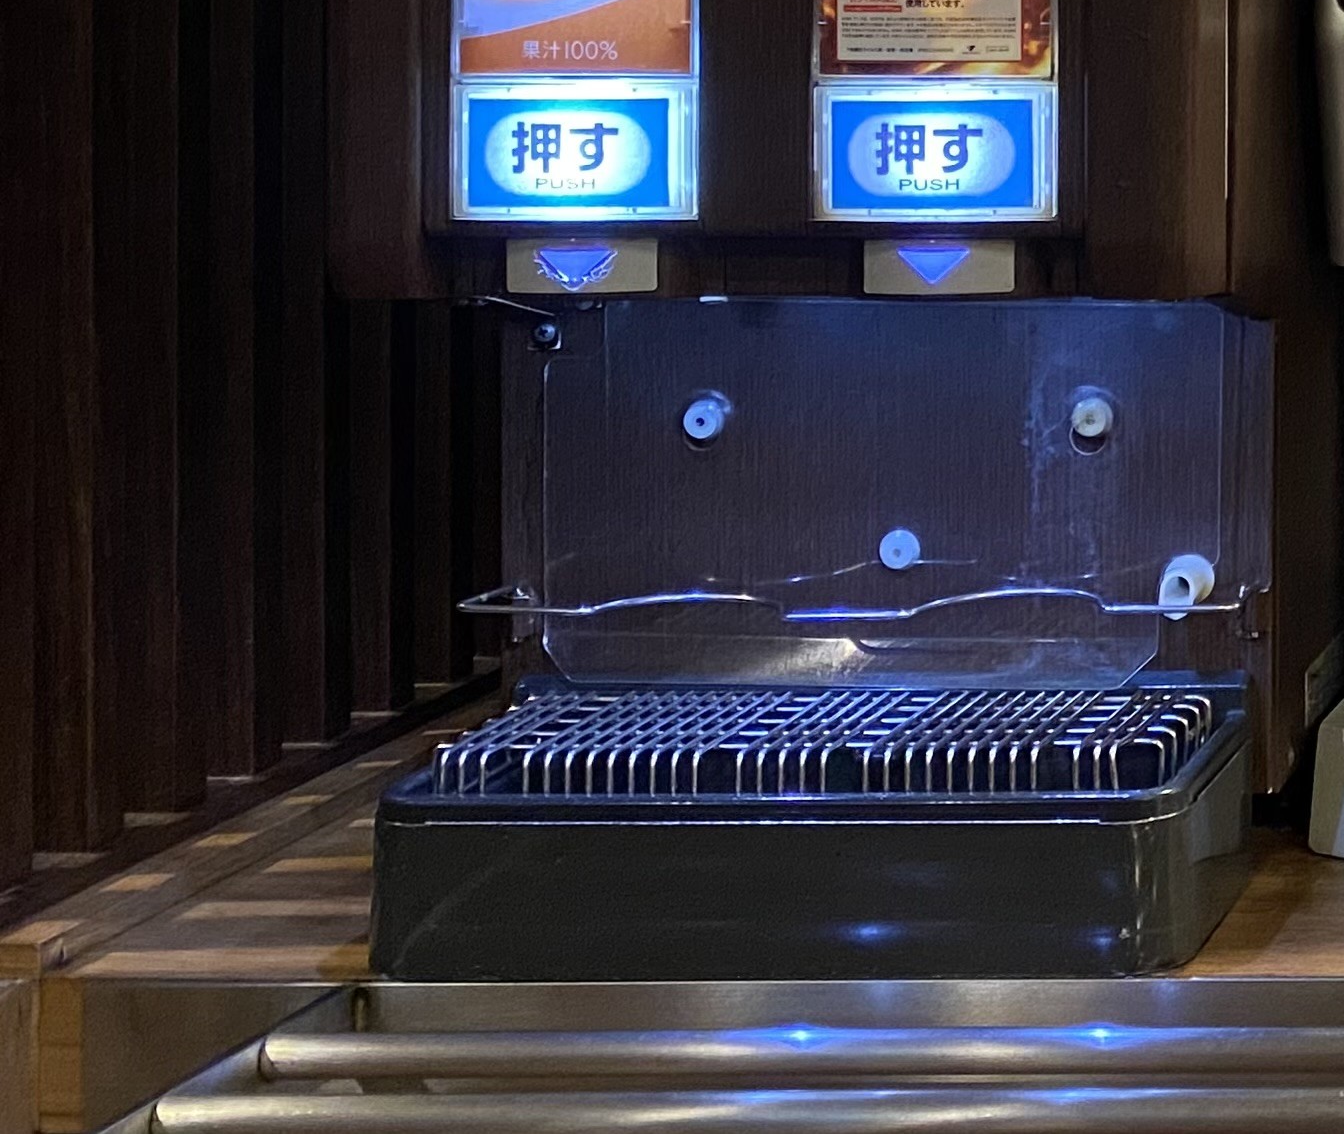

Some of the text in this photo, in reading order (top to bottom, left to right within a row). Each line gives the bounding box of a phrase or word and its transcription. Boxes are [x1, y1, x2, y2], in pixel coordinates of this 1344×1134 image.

[522, 40, 619, 61] 果汁100%
[512, 122, 619, 174] 押す
[875, 123, 983, 175] 押す
[536, 178, 596, 189] PUSH
[899, 179, 960, 191] PUSH
